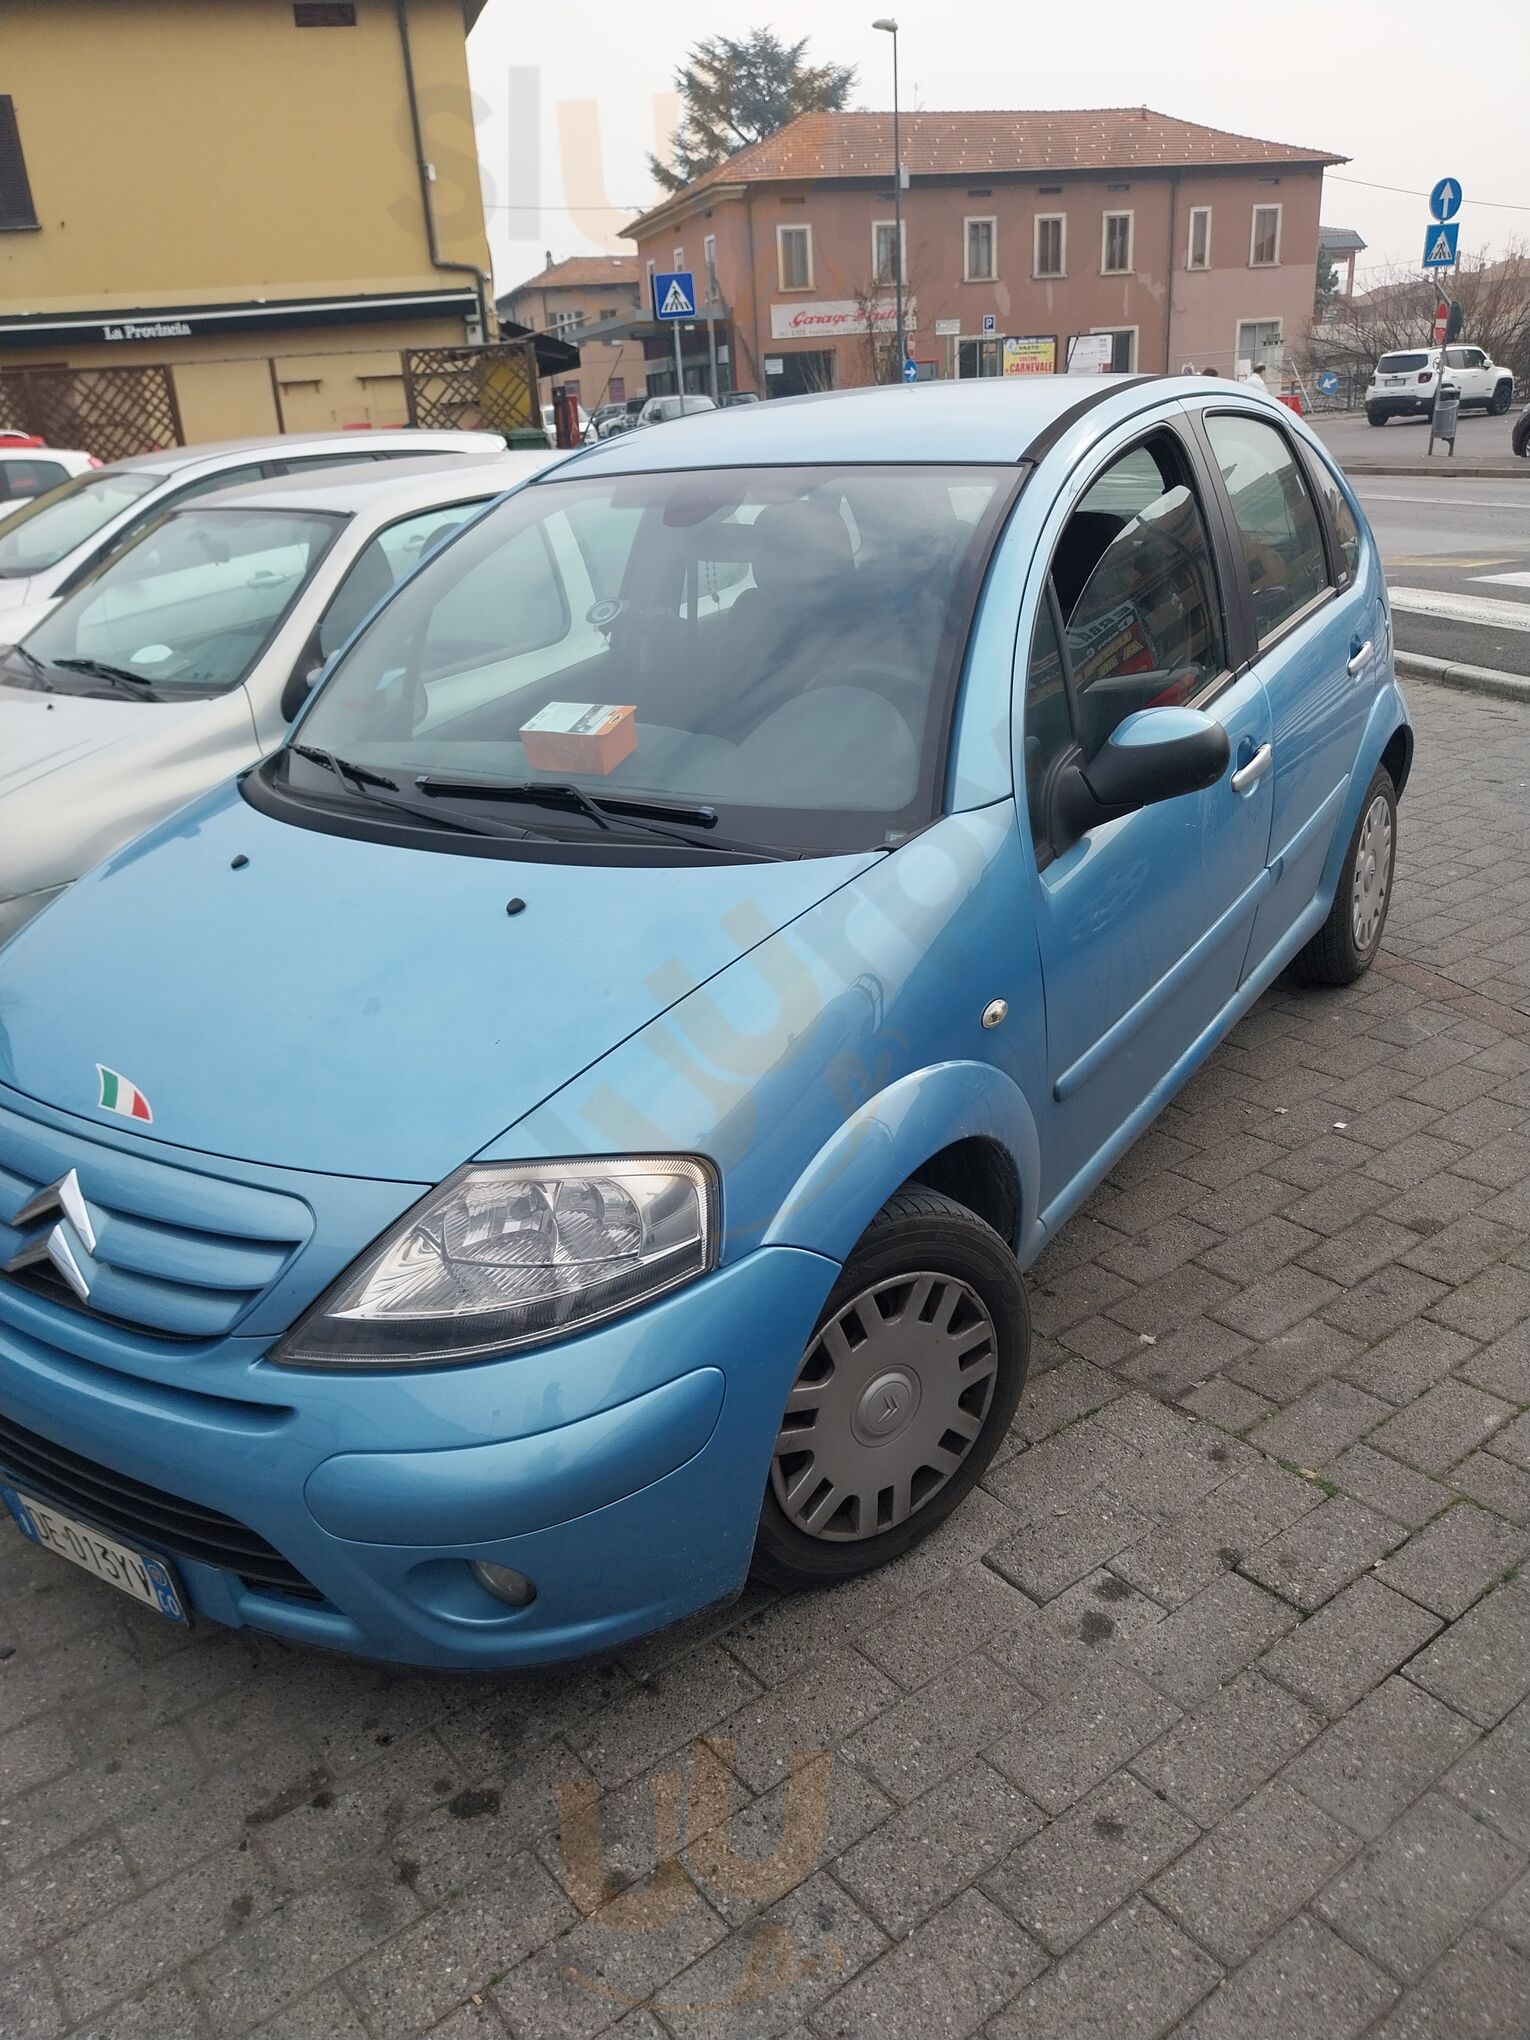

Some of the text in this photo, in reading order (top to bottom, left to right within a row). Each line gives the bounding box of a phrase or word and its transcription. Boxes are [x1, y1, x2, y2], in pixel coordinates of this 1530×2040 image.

[789, 310, 848, 328] Garage
[103, 326, 124, 341] La
[1009, 361, 1053, 374] CARNEVALE
